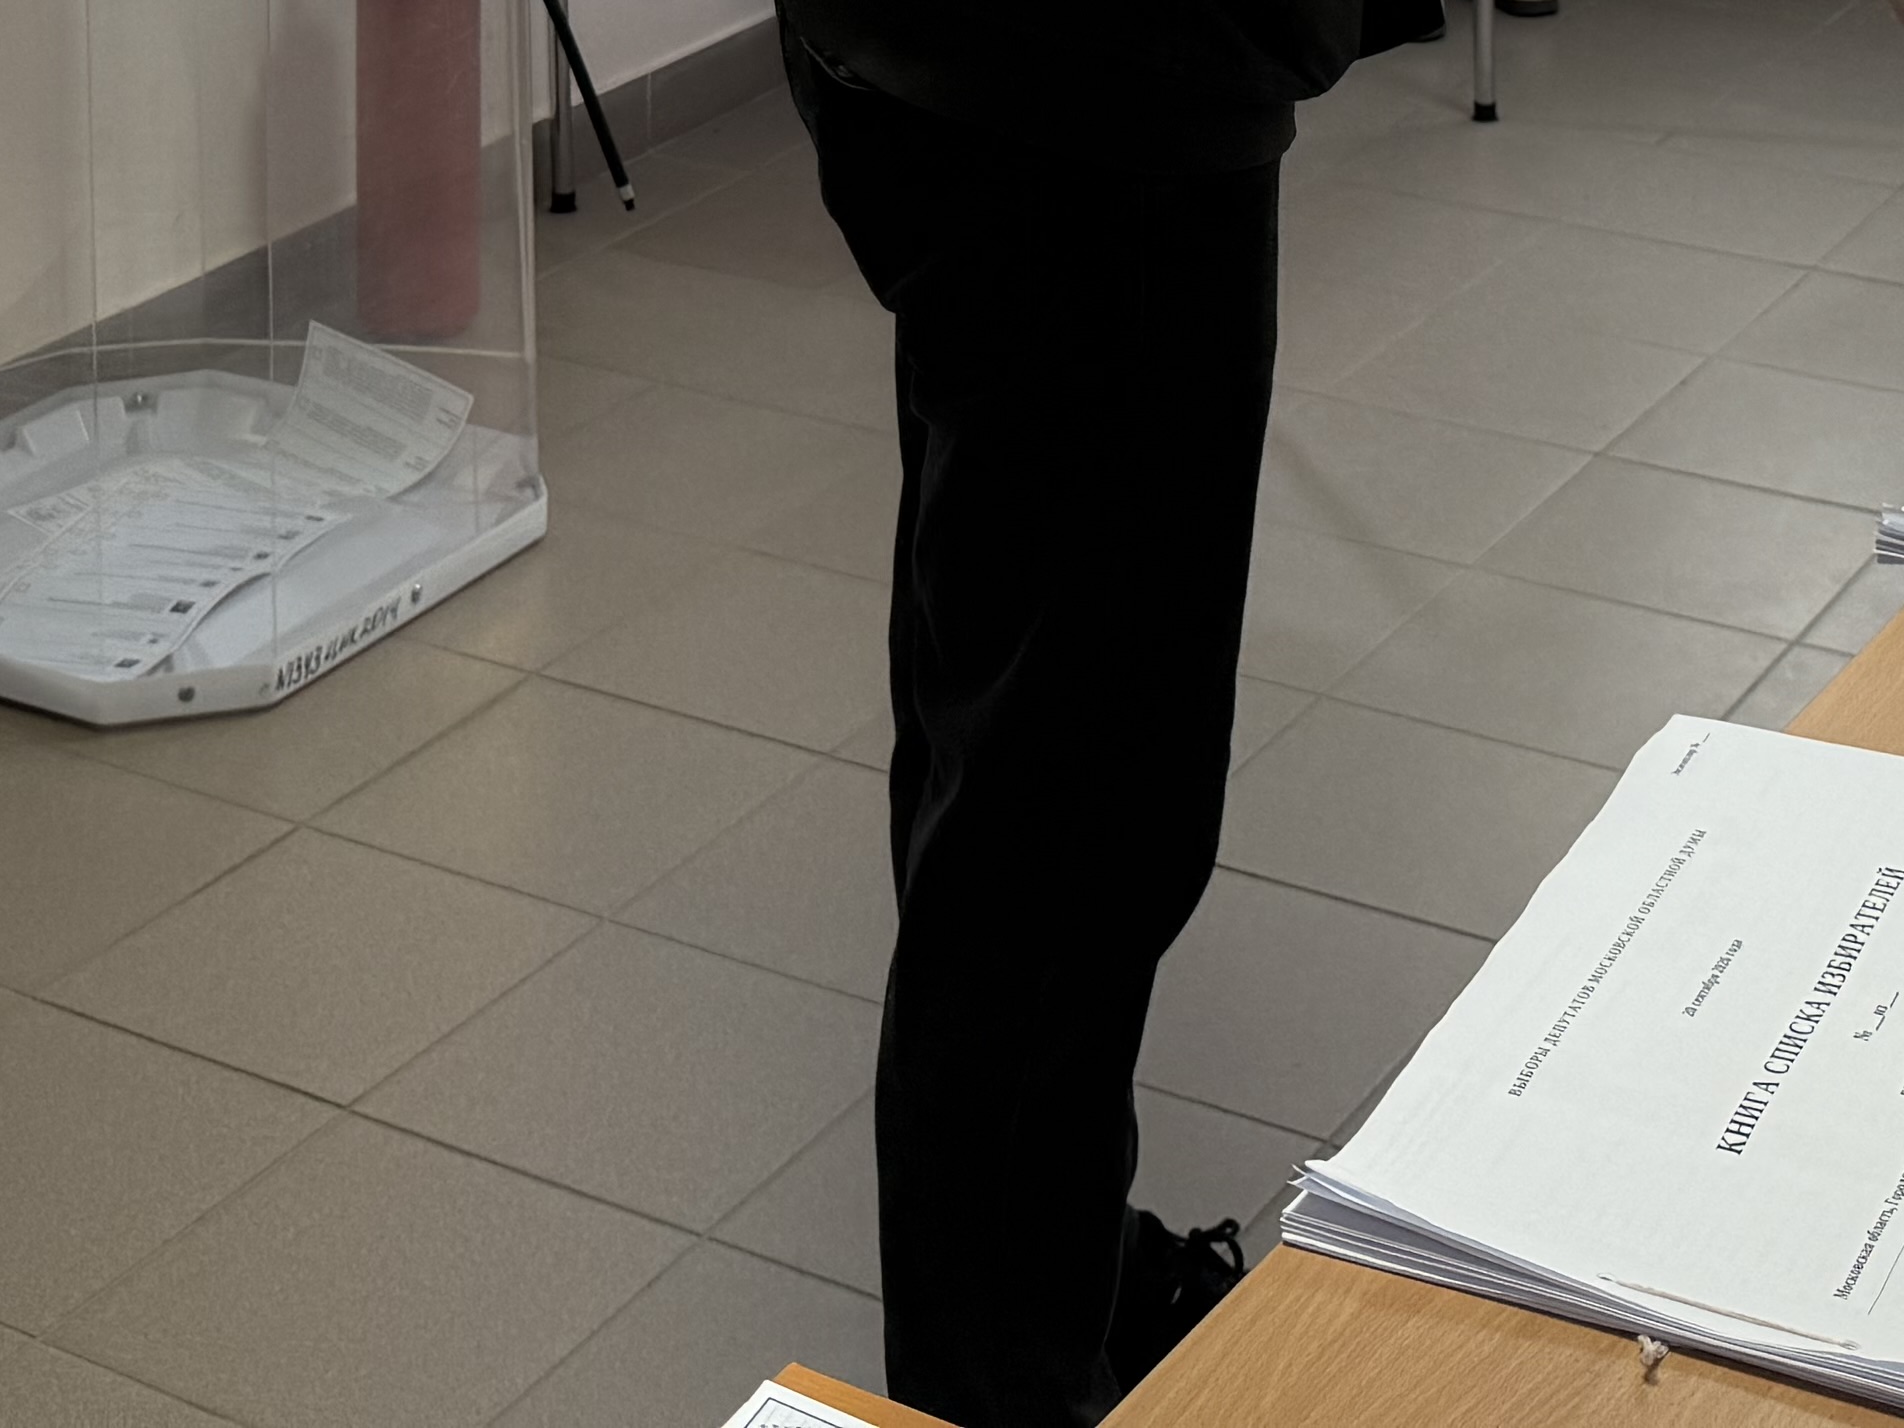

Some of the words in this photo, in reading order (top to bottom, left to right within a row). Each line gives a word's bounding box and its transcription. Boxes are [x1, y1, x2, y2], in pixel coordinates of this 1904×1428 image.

[1507, 1046, 1551, 1097] ВЫБОРЫ
[1543, 984, 1596, 1047] ДЕПУТАТОВ
[1587, 915, 1646, 985] МОСКОВСКОЙ
[1637, 857, 1687, 915] ОБЛАСТНОЙ
[1678, 828, 1707, 859] ДУМЫ
[1715, 1081, 1781, 1156] КНИГА
[1763, 1000, 1832, 1075] СПИСКА
